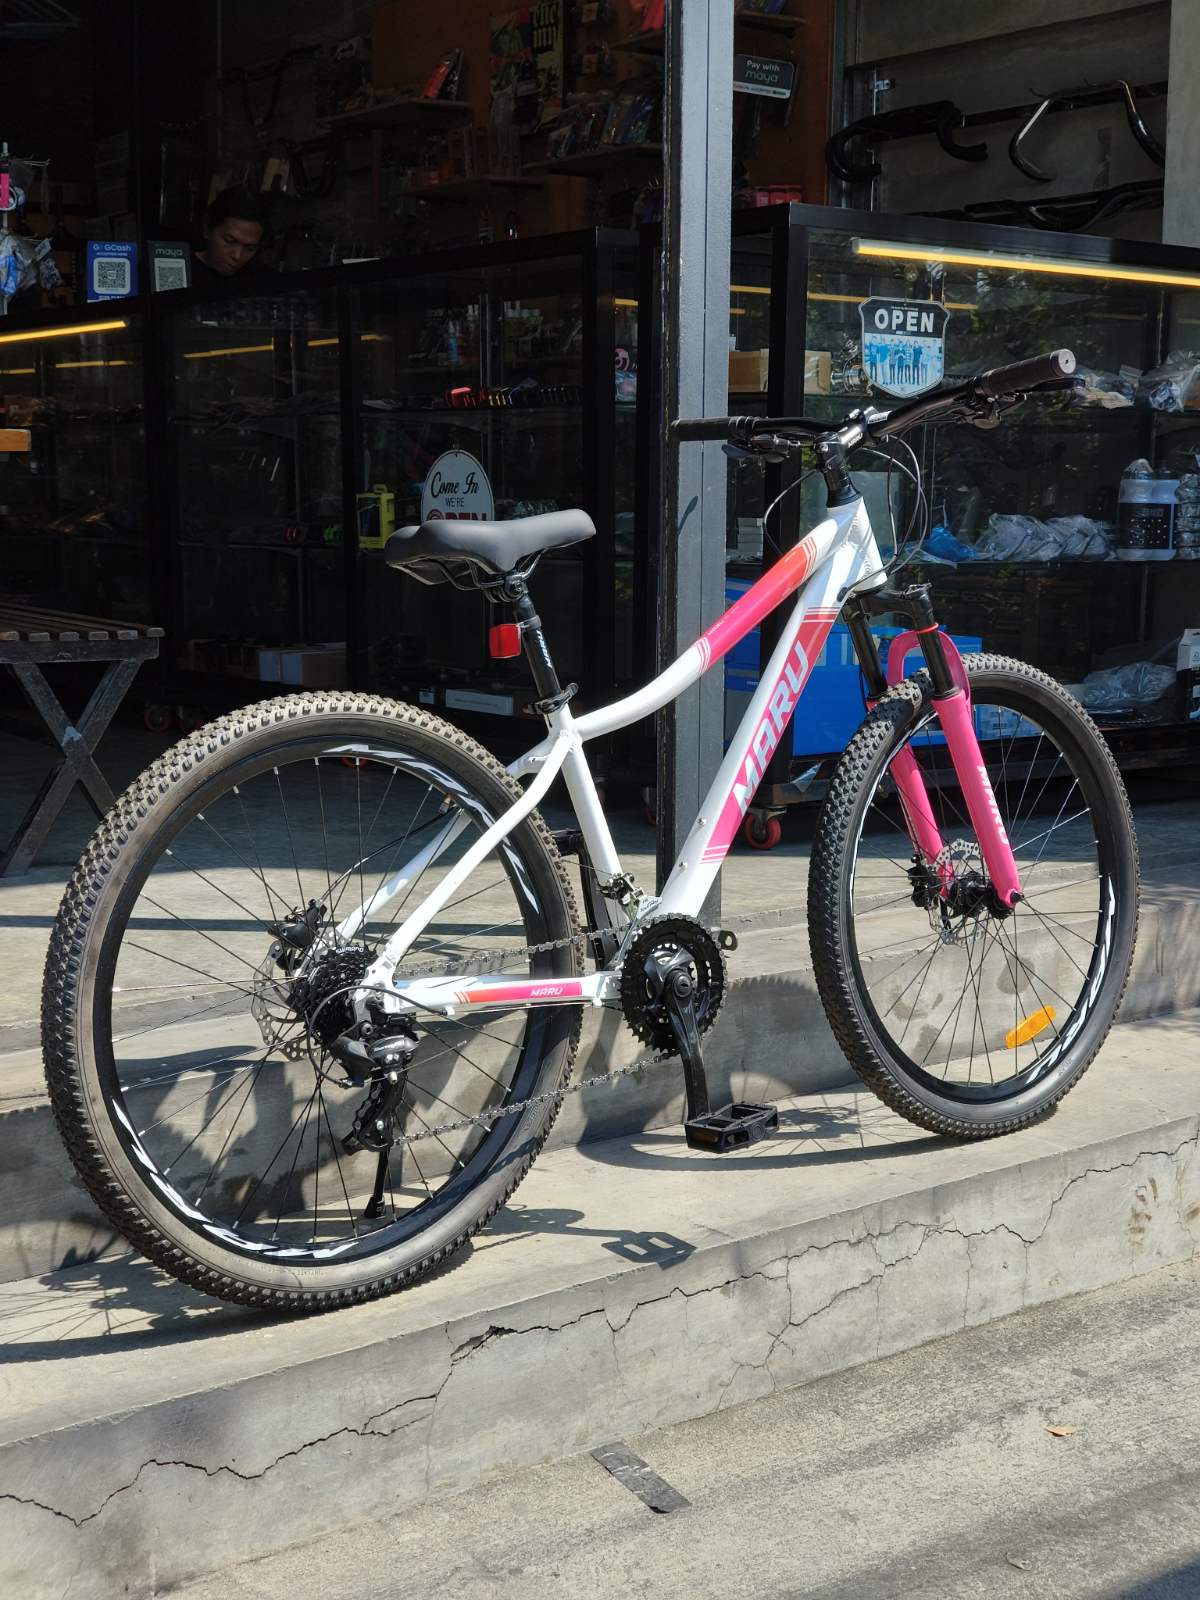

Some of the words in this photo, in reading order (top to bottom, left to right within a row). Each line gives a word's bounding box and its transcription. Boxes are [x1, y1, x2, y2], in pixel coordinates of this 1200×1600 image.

[746, 60, 761, 71] Pay
[762, 63, 780, 72] with
[745, 71, 778, 84] maya
[104, 244, 132, 252] GCash
[155, 248, 183, 257] maya
[874, 308, 934, 333] OPEN
[430, 471, 460, 498] Come
[463, 471, 479, 495] In
[732, 640, 809, 817] MARU
[529, 986, 564, 997] MARU
